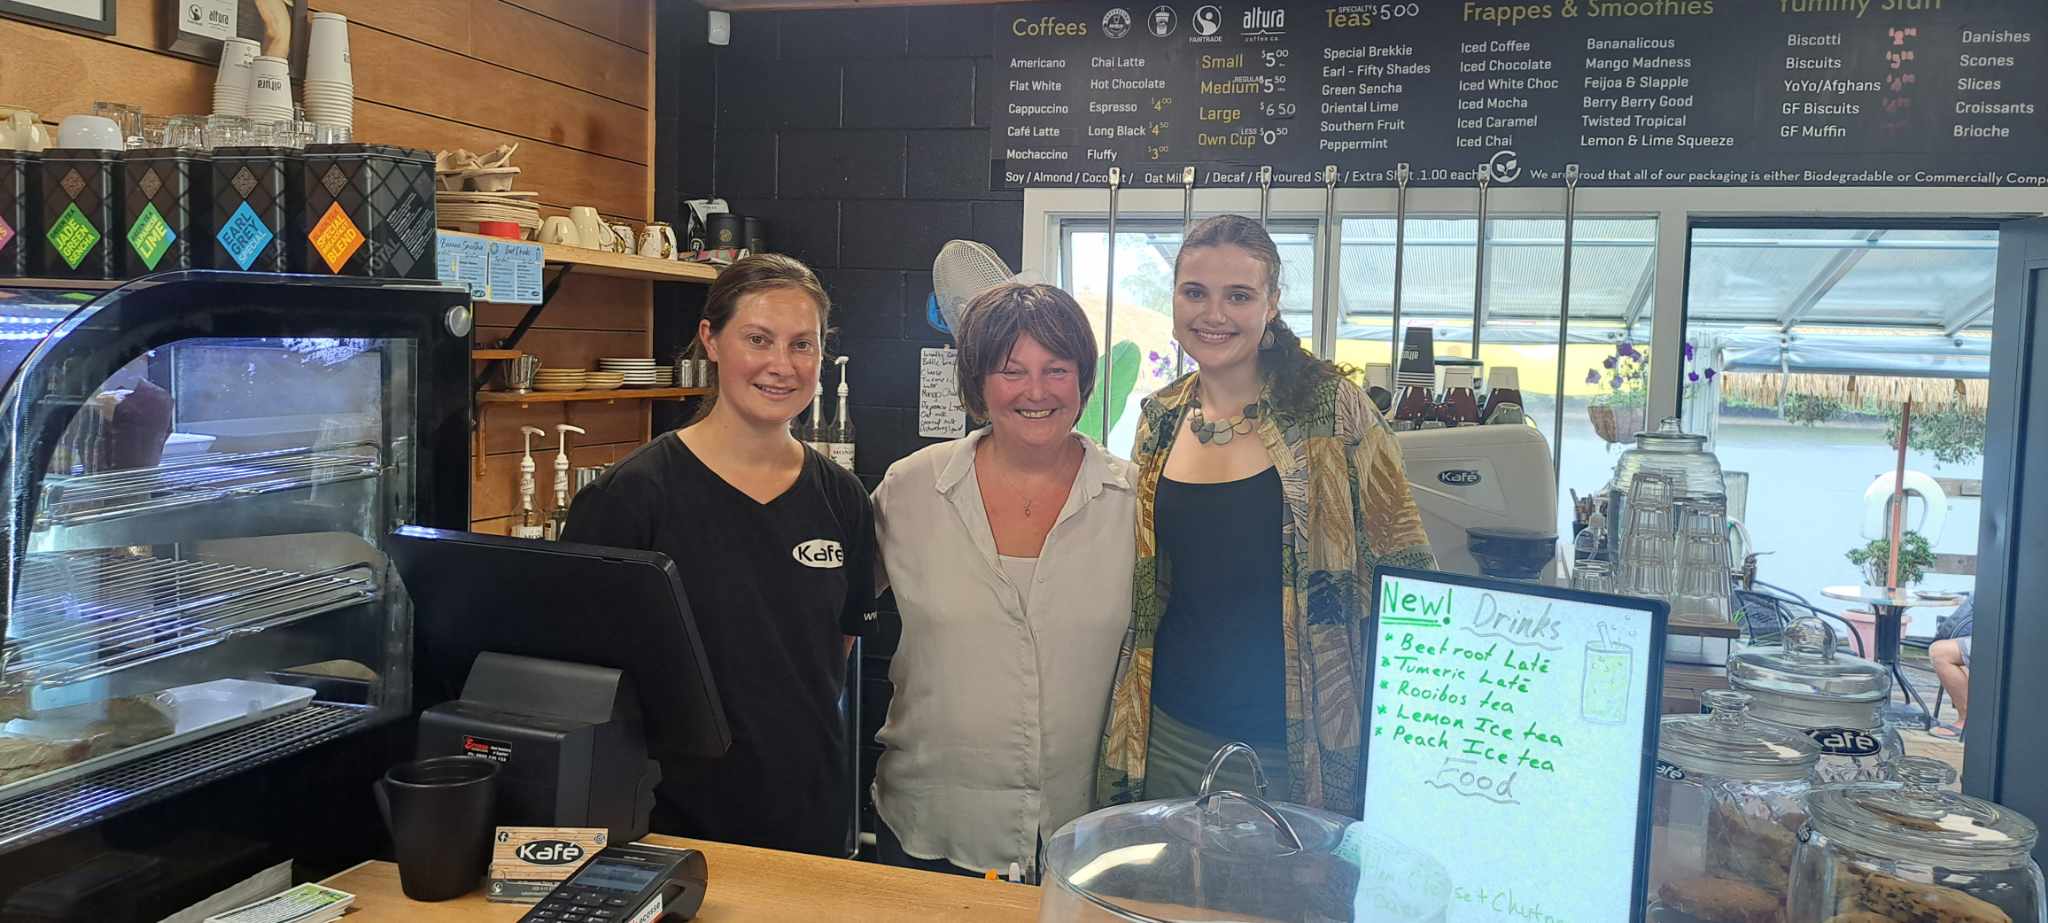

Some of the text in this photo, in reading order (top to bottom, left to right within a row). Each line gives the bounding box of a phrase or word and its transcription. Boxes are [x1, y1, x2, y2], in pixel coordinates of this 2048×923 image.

[1242, 7, 1285, 29] altura
[1325, 8, 1372, 28] Teas
[1463, 0, 1714, 26] Frappes & Smoothies
[1012, 16, 1088, 36] Coffees
[1586, 37, 1675, 50] Bananalicous
[1787, 33, 1841, 47] Biscotti
[1962, 30, 2032, 44] Danishes
[1323, 45, 1413, 61] Special Brekkie
[1461, 40, 1531, 53] Iced Coffee
[1010, 57, 1066, 69] Americano
[1091, 56, 1145, 68] Chai Latte
[1201, 54, 1244, 69] Small
[1460, 59, 1552, 73] Iced Chocolate
[1585, 56, 1692, 72] Mango Madness
[1785, 56, 1842, 69] Biscuits
[1959, 54, 2014, 67] Scones
[1323, 63, 1431, 78] Earl Fifty Shades
[1009, 80, 1062, 91] Flat White
[1090, 78, 1166, 90] Hot Chocolate
[1200, 80, 1260, 95] Medium
[1321, 82, 1402, 96] Green Sencha
[1459, 77, 1559, 92] Iced White Choc
[1584, 75, 1689, 91] Feijoa & Slapple
[1784, 79, 1881, 95] YoYo/Afghans
[1957, 77, 2001, 91] Slices
[1008, 103, 1069, 116] Cappuccino
[1089, 102, 1138, 115] Espresso
[1321, 101, 1399, 114] Oriental Lime
[1458, 97, 1528, 110] Iced Mocha
[1583, 95, 1694, 110] Berry Berry Good
[1782, 102, 1860, 115] GF Biscuits
[1955, 101, 2034, 114] Croissants
[1199, 106, 1241, 123] Large
[1582, 114, 1687, 129] Twisted Tropical
[1320, 119, 1406, 132] Southern Fruit
[1457, 115, 1538, 129] Iced Caramel
[1007, 125, 1060, 138] Café Latte
[1088, 125, 1114, 138] Long
[1117, 125, 1147, 137] Black
[1780, 125, 1846, 137] GF Muffin
[1953, 124, 2010, 138] Brioche
[1198, 133, 1227, 146] Own
[1230, 132, 1256, 148] Cup
[1319, 138, 1388, 152] Peppermint
[1456, 135, 1513, 147] Iced Chai
[1580, 134, 1735, 149] Lemon & Lime Squeeze
[1006, 149, 1068, 160] Mochaccino
[1087, 149, 1118, 162] Fluffy
[1005, 171, 1025, 184] Soy
[1033, 171, 1073, 183] Almond
[1082, 172, 1127, 184] Cocot
[1144, 172, 1164, 184] Oat
[1212, 171, 1245, 183] Decaf
[1255, 170, 1311, 183] Fvoured
[1352, 170, 1383, 182] Extra
[1386, 170, 1413, 182] Sht
[1530, 170, 1548, 180] We
[1579, 170, 1605, 180] roud
[1608, 169, 1631, 181] that
[1634, 169, 1648, 180] all
[1652, 169, 1664, 181] of
[1665, 172, 1686, 180] our
[1688, 169, 1748, 183] packaging
[1751, 170, 1760, 181] is
[1763, 170, 1800, 181] either
[1803, 170, 1894, 184] Biodegradable
[1897, 173, 1911, 182] or
[1914, 171, 2003, 185] Commercially
[2006, 172, 2048, 187] Comp
[222, 212, 252, 245] EARL
[140, 219, 168, 258] LIME
[231, 219, 258, 255] GREY
[327, 227, 357, 263] BLEND
[1441, 470, 1477, 483] Kafé
[1382, 580, 1453, 626] New!
[1472, 592, 1561, 642] Drinks
[1393, 655, 1465, 680] Tumeric
[1397, 680, 1515, 715] Rooibos tea
[1397, 704, 1564, 748] Lemon Ice tea
[1392, 725, 1556, 773] Peach Ice tea
[1437, 757, 1517, 798] Food
[1655, 763, 1683, 780] afé
[520, 842, 580, 861] Kafé
